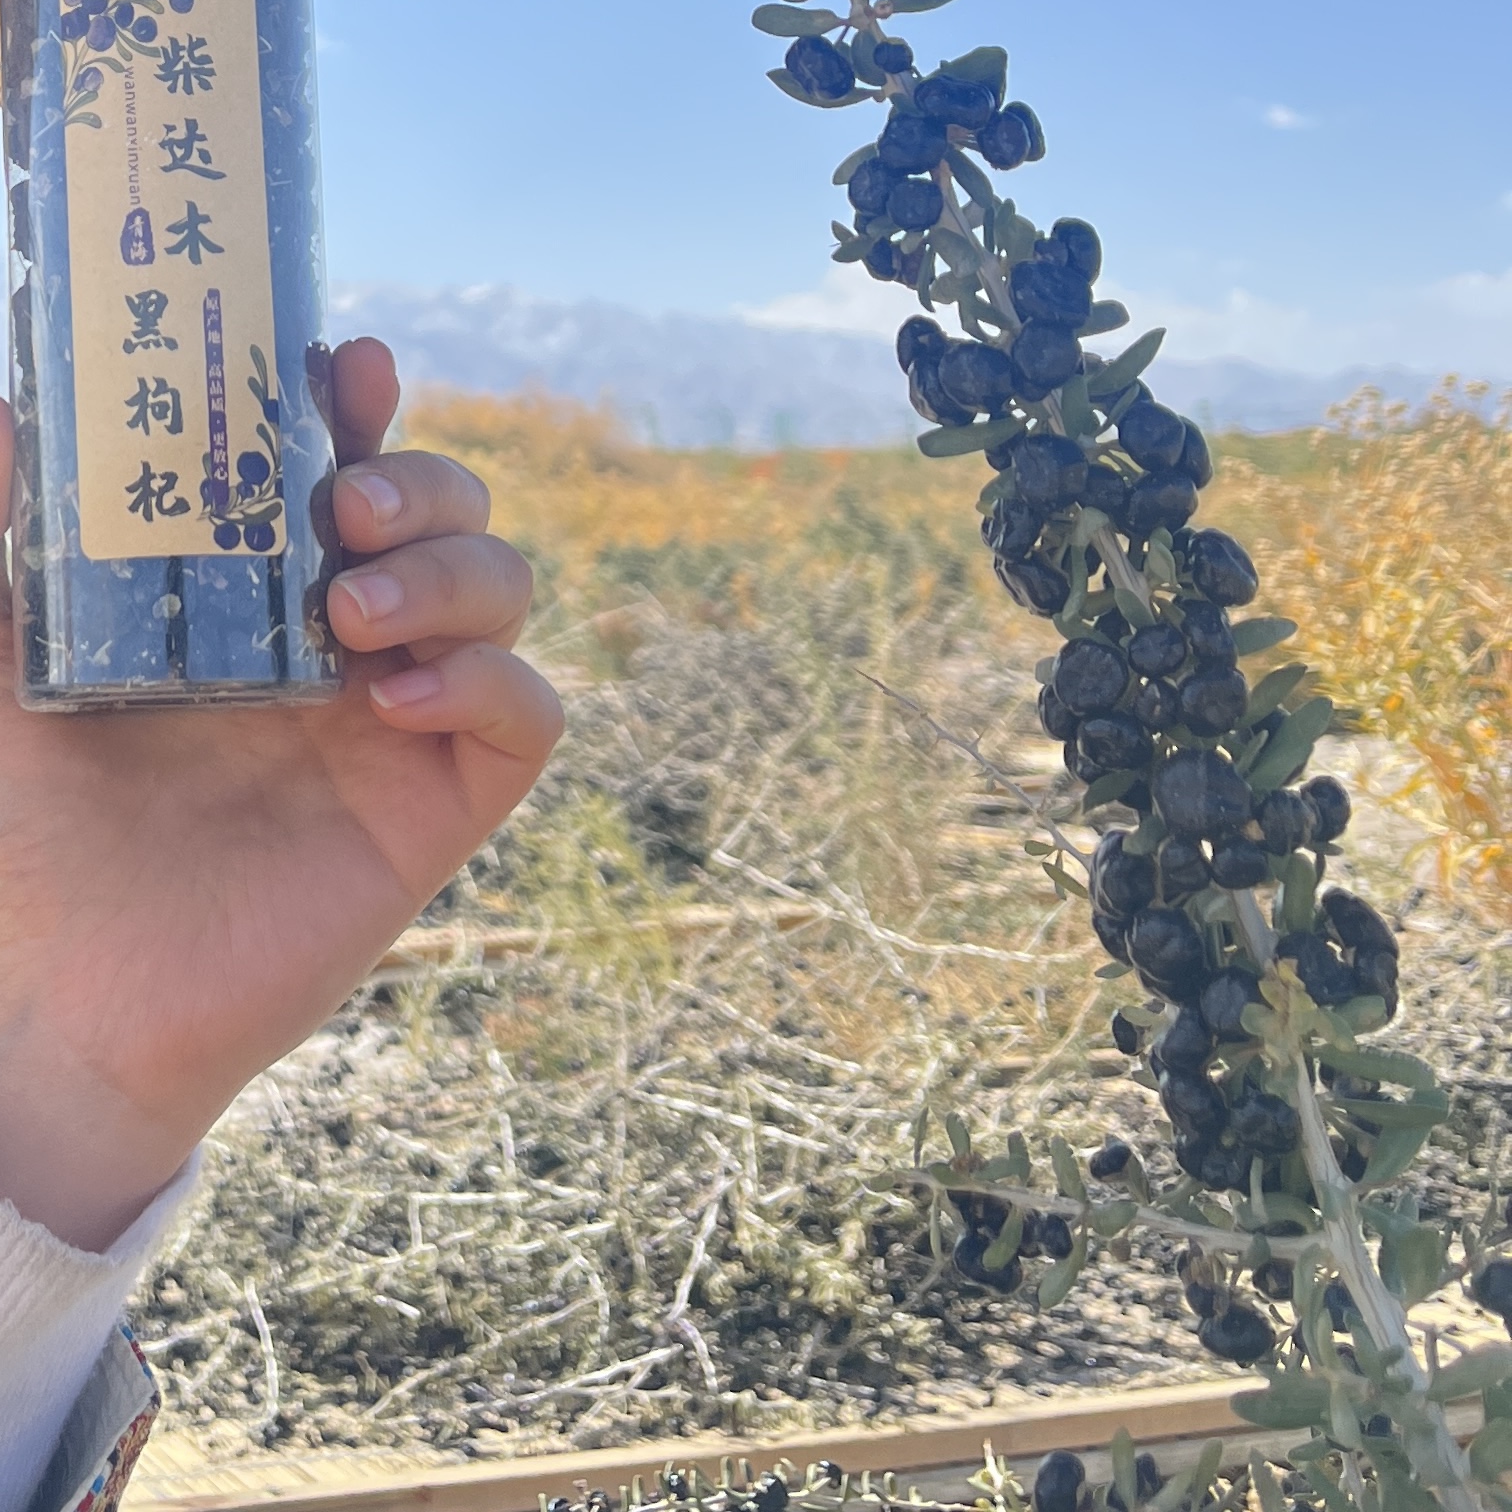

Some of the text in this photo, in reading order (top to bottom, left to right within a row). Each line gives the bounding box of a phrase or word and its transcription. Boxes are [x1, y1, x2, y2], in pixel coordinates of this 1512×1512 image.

[123, 65, 141, 206] wanwanxinxuan
[153, 33, 227, 265] 柴达木
[122, 289, 192, 524] 黑枸杞
